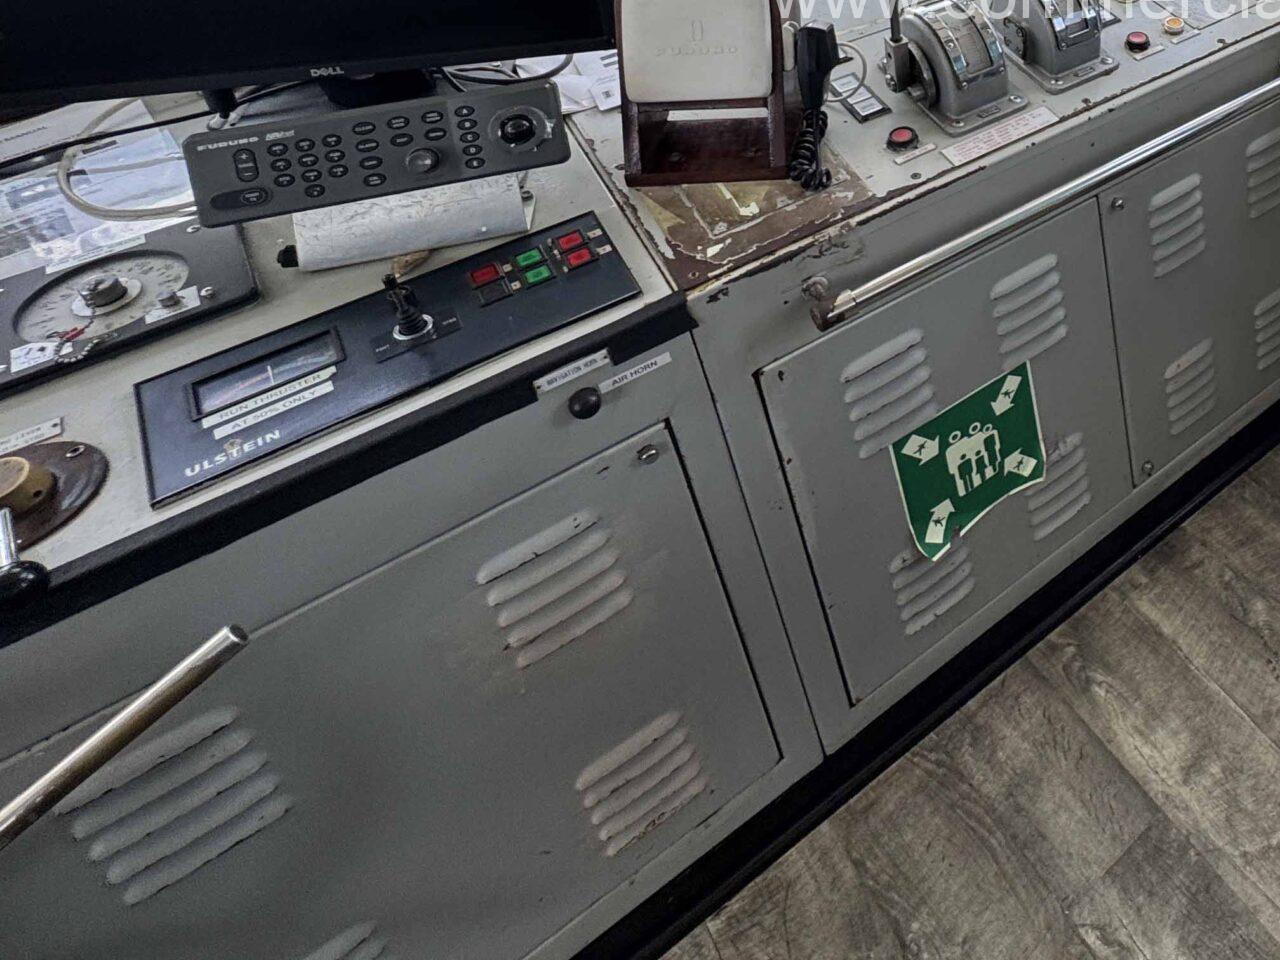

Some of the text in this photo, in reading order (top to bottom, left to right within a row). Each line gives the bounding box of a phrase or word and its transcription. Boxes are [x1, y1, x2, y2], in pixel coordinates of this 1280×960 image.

[310, 66, 345, 77] DELL
[197, 136, 259, 151] FURUNO
[611, 359, 658, 387] AIR HORN
[219, 373, 322, 420] RUN THRUSTER
[231, 390, 318, 430] AT 50% ONLY
[184, 429, 281, 477] ULSTEIN
